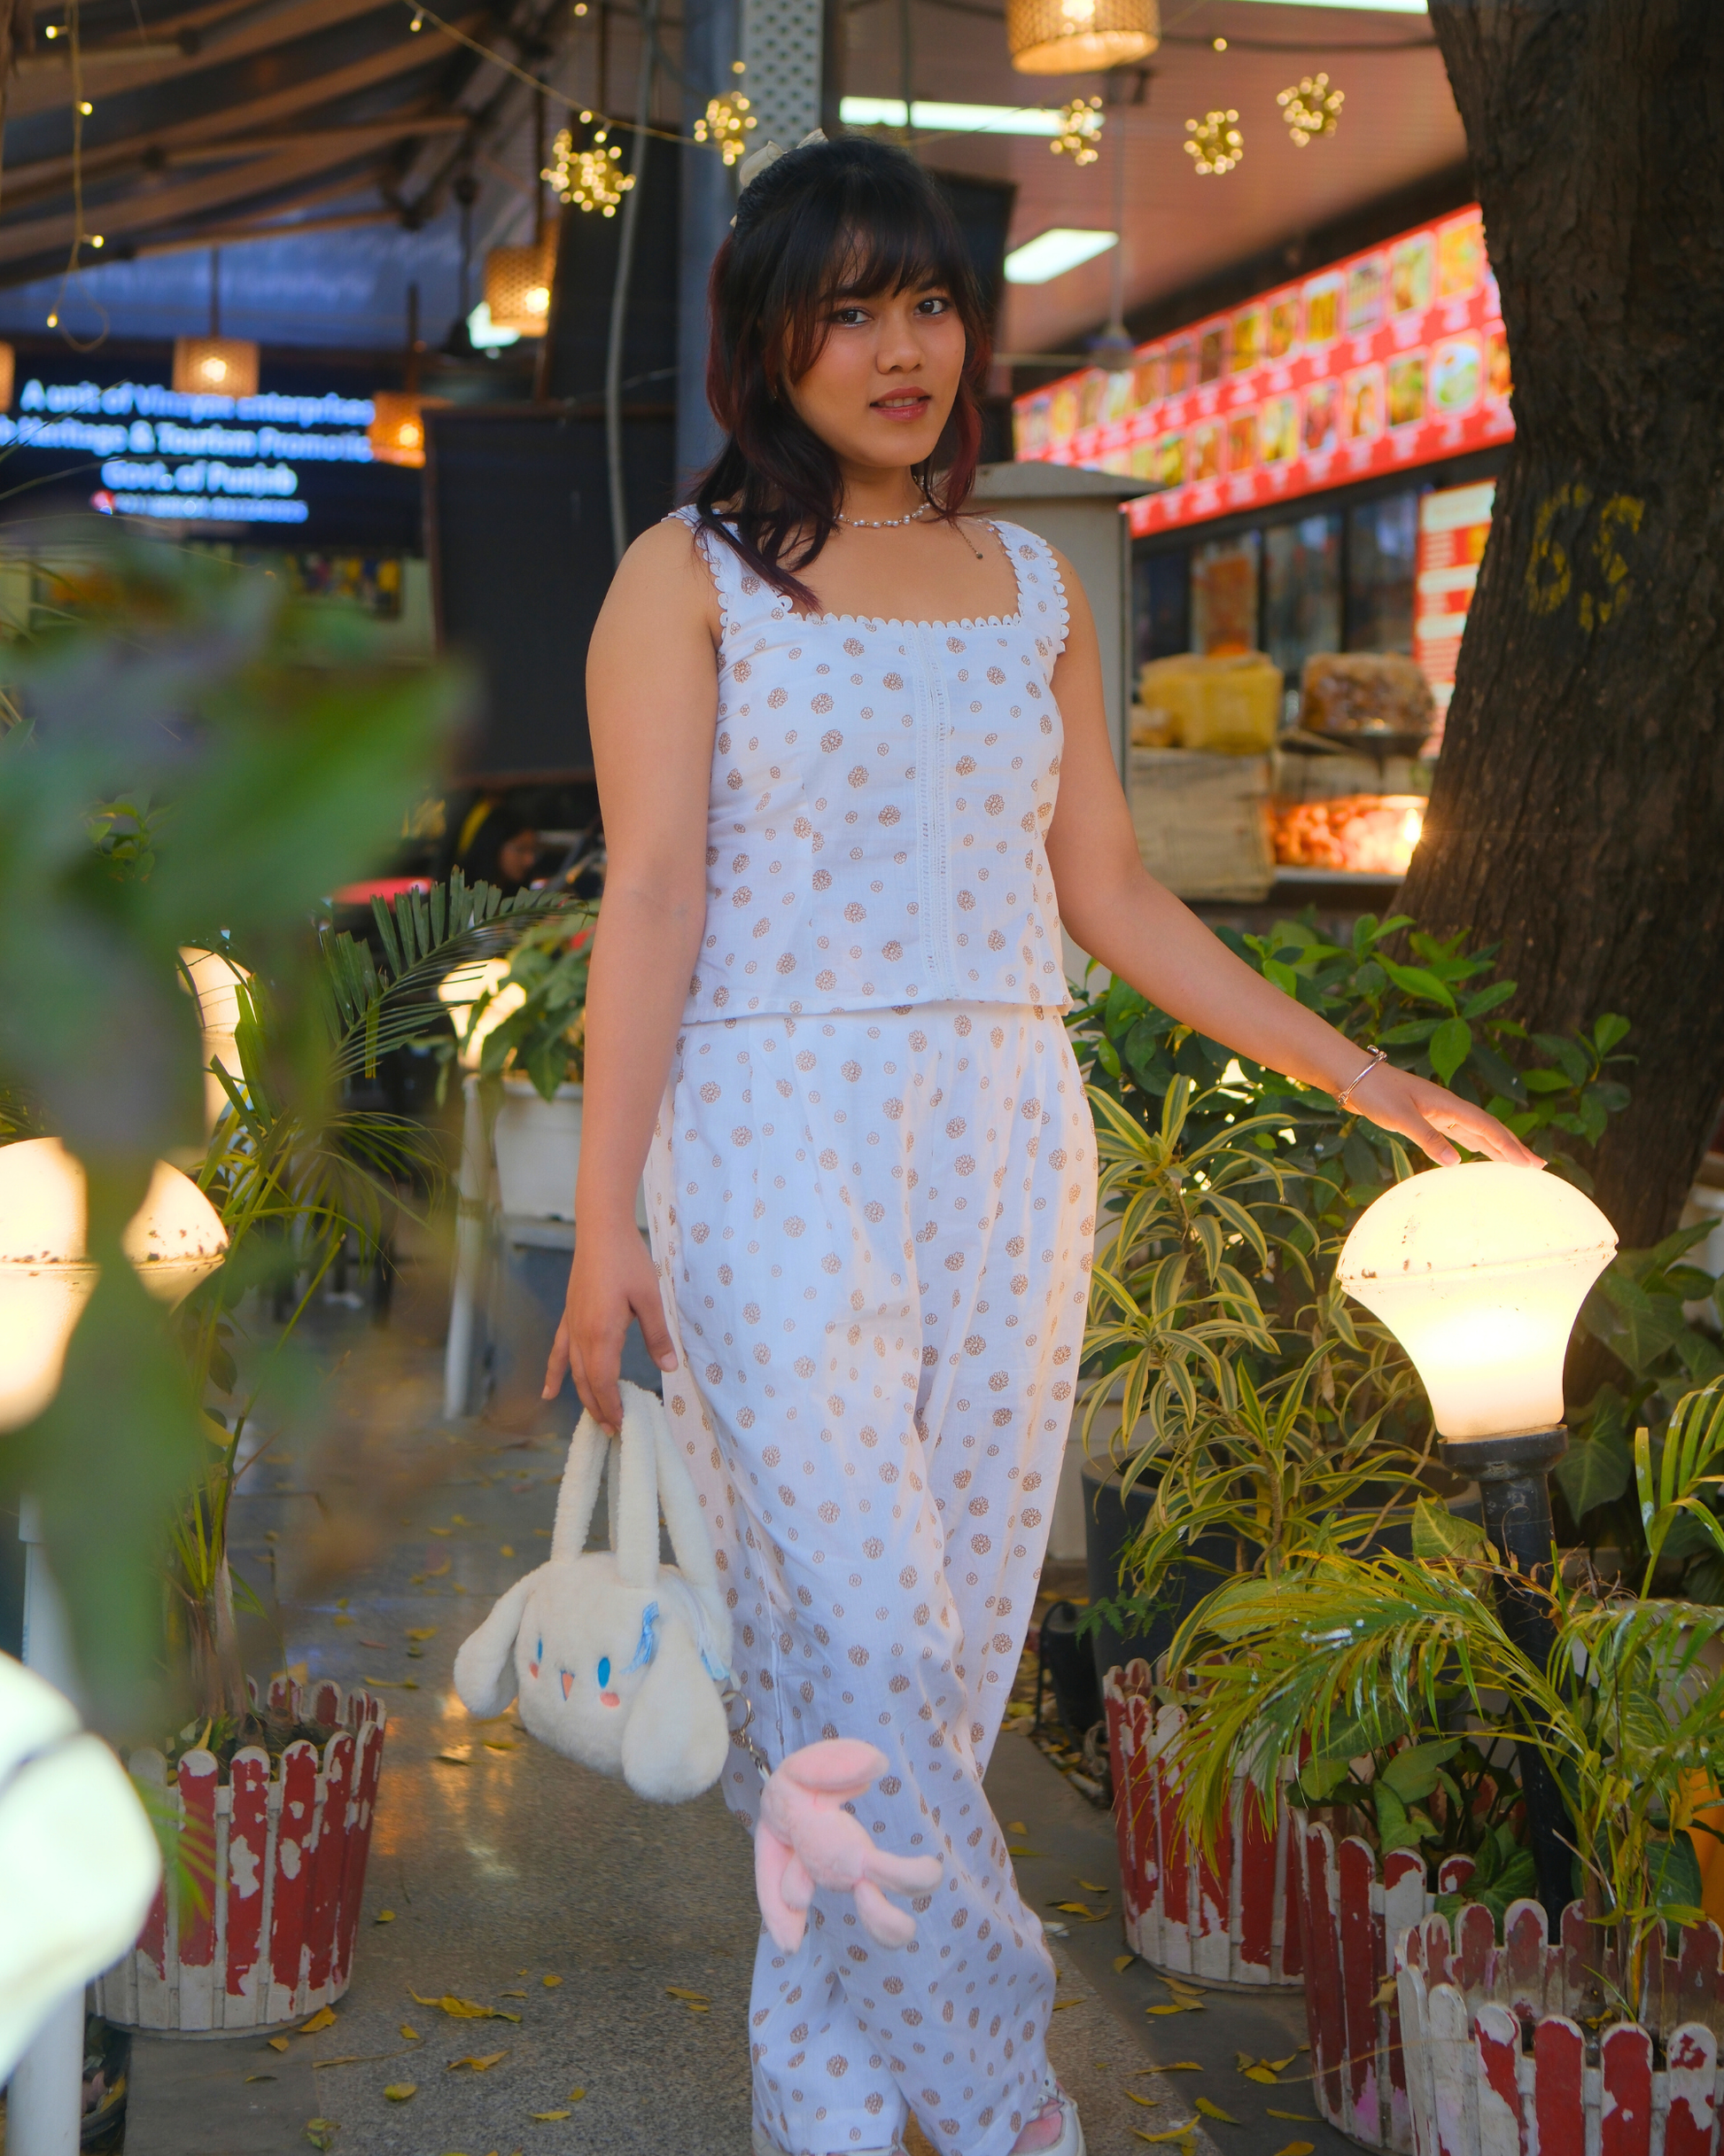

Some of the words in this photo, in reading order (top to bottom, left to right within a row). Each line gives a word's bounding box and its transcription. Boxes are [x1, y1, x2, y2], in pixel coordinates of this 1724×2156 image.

[19, 378, 45, 412] A
[100, 382, 134, 415] of
[128, 420, 155, 454] &
[155, 422, 258, 457] Tourism
[175, 459, 207, 493] of
[207, 461, 298, 496] Punjab
